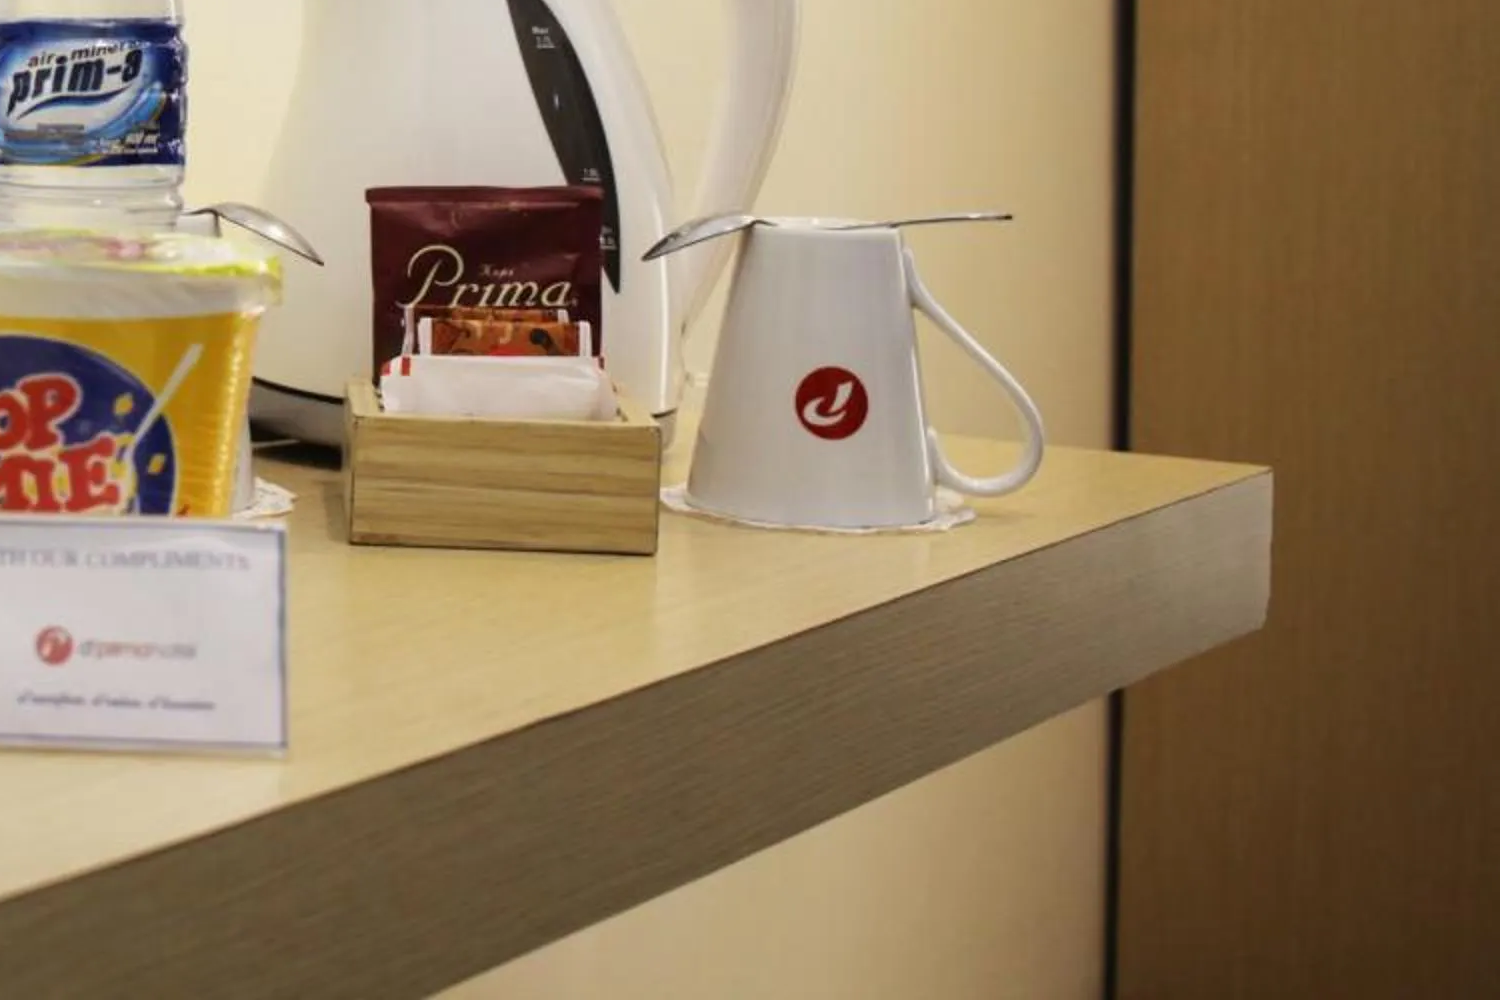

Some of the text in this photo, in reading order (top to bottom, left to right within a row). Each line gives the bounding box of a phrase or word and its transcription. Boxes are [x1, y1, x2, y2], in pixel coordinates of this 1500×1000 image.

[27, 51, 57, 67] air
[6, 49, 143, 117] prim-a
[396, 244, 572, 308] Prima
[30, 548, 79, 569] OUR
[86, 550, 249, 571] COMPLIMENTS
